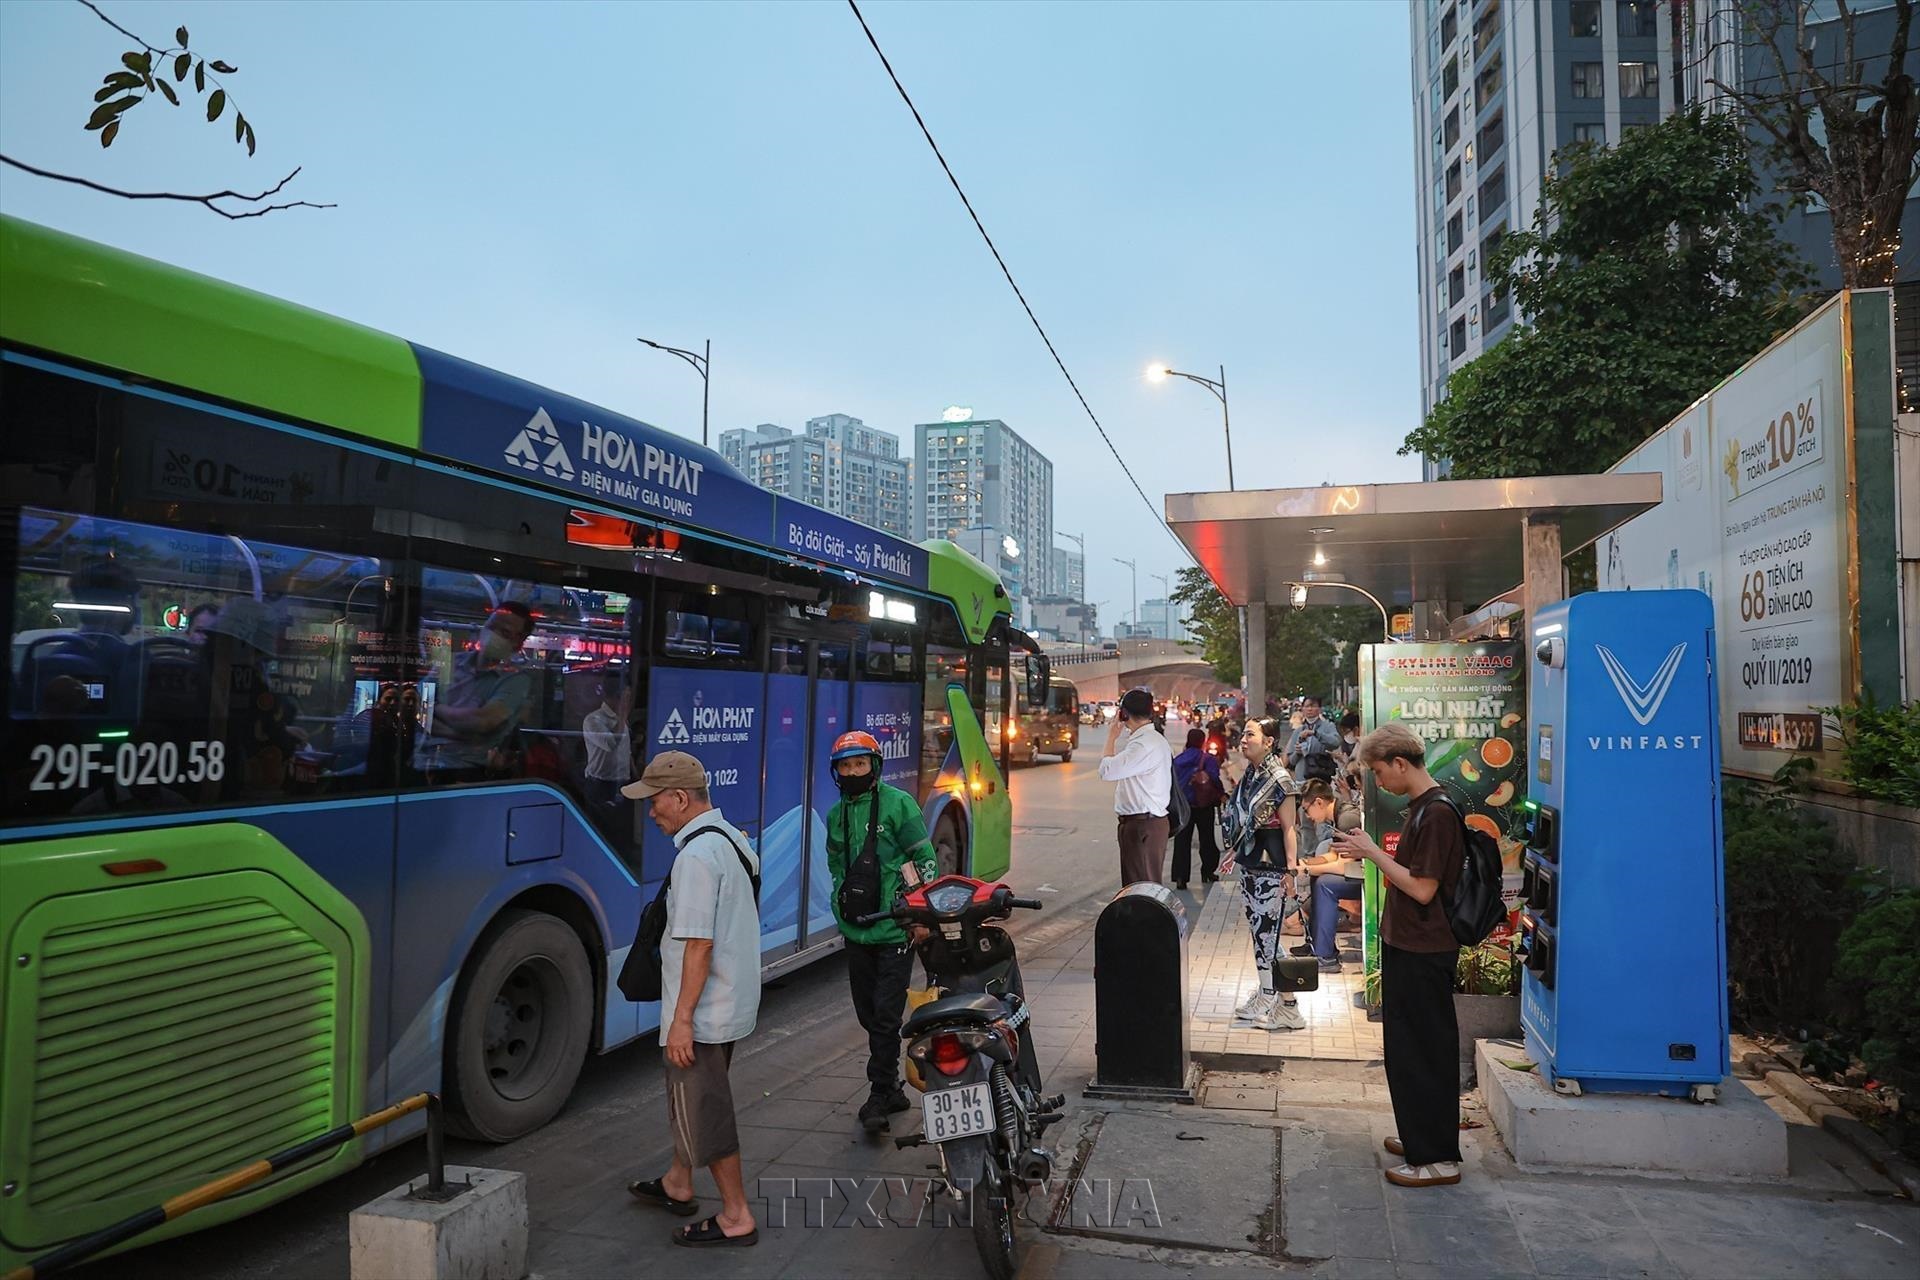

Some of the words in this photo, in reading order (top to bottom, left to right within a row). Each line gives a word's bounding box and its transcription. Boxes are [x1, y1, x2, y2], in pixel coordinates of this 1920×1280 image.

[1766, 397, 1814, 471] 10%
[1741, 439, 1766, 463] THANH
[1796, 437, 1816, 457] GTCH
[643, 443, 704, 496] PHÁT
[1746, 458, 1767, 481] TOÁN
[581, 469, 611, 494] ĐIỆN
[614, 479, 640, 501] MÁY
[641, 488, 660, 507] GIA
[662, 495, 693, 517] DỤNG
[789, 523, 803, 552] Bộ
[823, 534, 845, 562] Giặt
[854, 543, 871, 569] Sấy
[873, 543, 911, 577] Funiki
[1783, 537, 1797, 553] CAO
[1741, 570, 1765, 622] 68
[1767, 563, 1786, 590] TIỆN
[1787, 559, 1804, 583] ÍCH
[1792, 589, 1813, 612] CAO
[1785, 633, 1799, 650] giao
[1388, 657, 1457, 669] SKYLINE
[1463, 655, 1513, 669] VMAC
[1742, 654, 1767, 690] QUÝ
[1769, 657, 1812, 686] II/2019
[1447, 694, 1506, 720] NHẤT
[866, 713, 875, 731] Bộ
[1408, 720, 1451, 742] VIỆT
[1453, 722, 1496, 739] NAM
[721, 733, 732, 742] GIA
[732, 732, 749, 744] DỤNG
[880, 731, 910, 761] uniki
[1588, 735, 1703, 751] VINFAST
[29, 741, 226, 792] 29F-020.58
[714, 768, 738, 786] 1022
[931, 1086, 981, 1114] 30-N4
[935, 1109, 985, 1138] 8399
